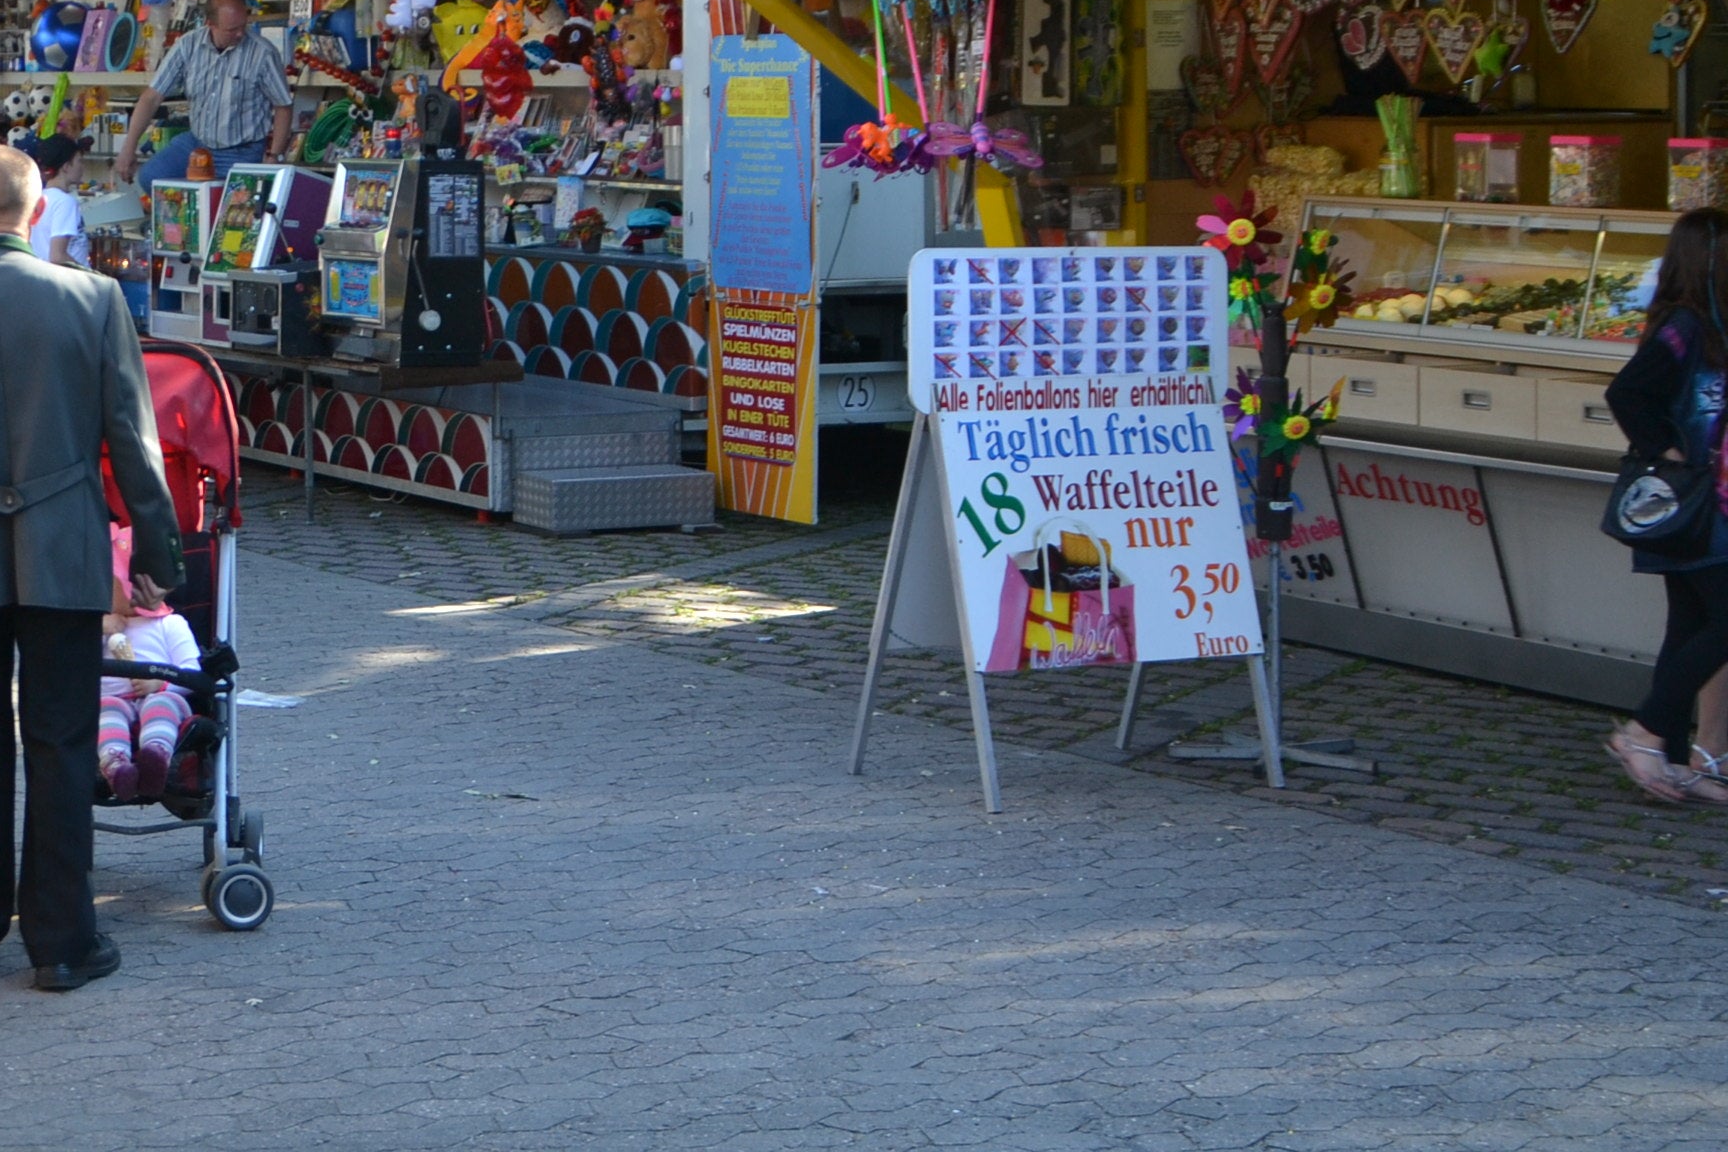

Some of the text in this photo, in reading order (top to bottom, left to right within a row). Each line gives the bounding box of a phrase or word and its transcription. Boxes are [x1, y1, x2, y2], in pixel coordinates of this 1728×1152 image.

[724, 306, 796, 325] GLÜCKSTREFFTÜTE
[723, 322, 796, 343] SPIELMÜNZEN
[723, 339, 795, 360] KUGELSTECHEN
[723, 356, 795, 377] RUBBELKARTEN
[723, 375, 795, 394] BINGOKARTEN
[844, 376, 869, 408] 25
[939, 383, 969, 412] Alle
[977, 380, 1080, 411] Folienballons
[1088, 378, 1119, 408] hier
[730, 392, 785, 410] UND LOSE
[727, 408, 790, 428] IN EINER TÜTE
[776, 431, 795, 446] EURO
[957, 411, 1215, 474] Täglich frisch
[776, 448, 795, 462] EURO
[1335, 461, 1487, 527] Achtung
[957, 471, 1027, 559] 18
[1031, 468, 1220, 512] Waffelteile
[1124, 515, 1194, 549] nur
[1170, 562, 1241, 624] 3,50
[1194, 631, 1250, 658] Euro
